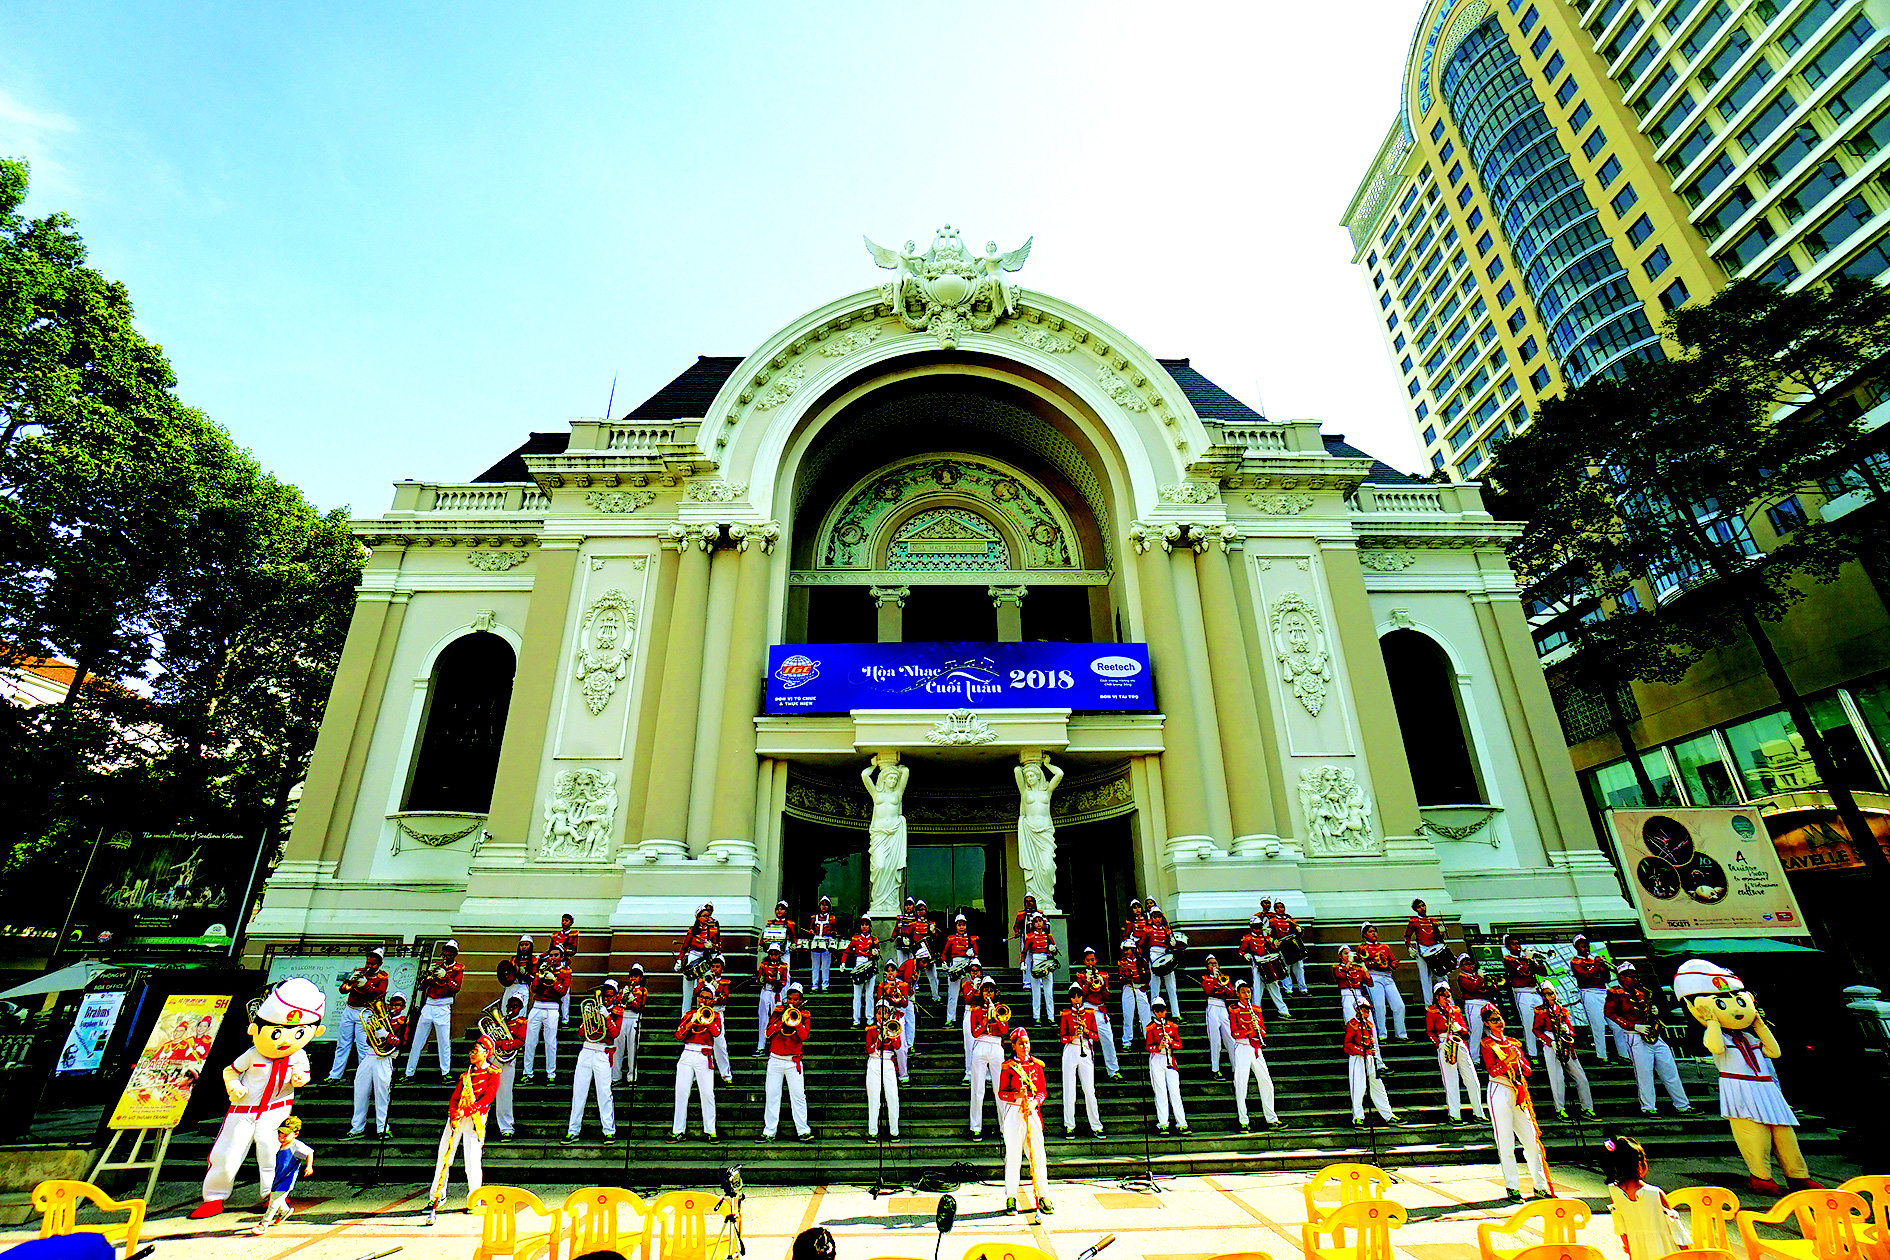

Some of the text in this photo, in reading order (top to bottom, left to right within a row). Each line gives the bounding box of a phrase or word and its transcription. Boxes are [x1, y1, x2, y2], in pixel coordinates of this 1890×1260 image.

[862, 665, 942, 683] Hòa Nhạc
[1097, 662, 1136, 671] Reetech
[925, 679, 961, 694] Cuối
[1009, 669, 1075, 689] 2018
[1735, 850, 1748, 865] A
[214, 998, 230, 1009] SH
